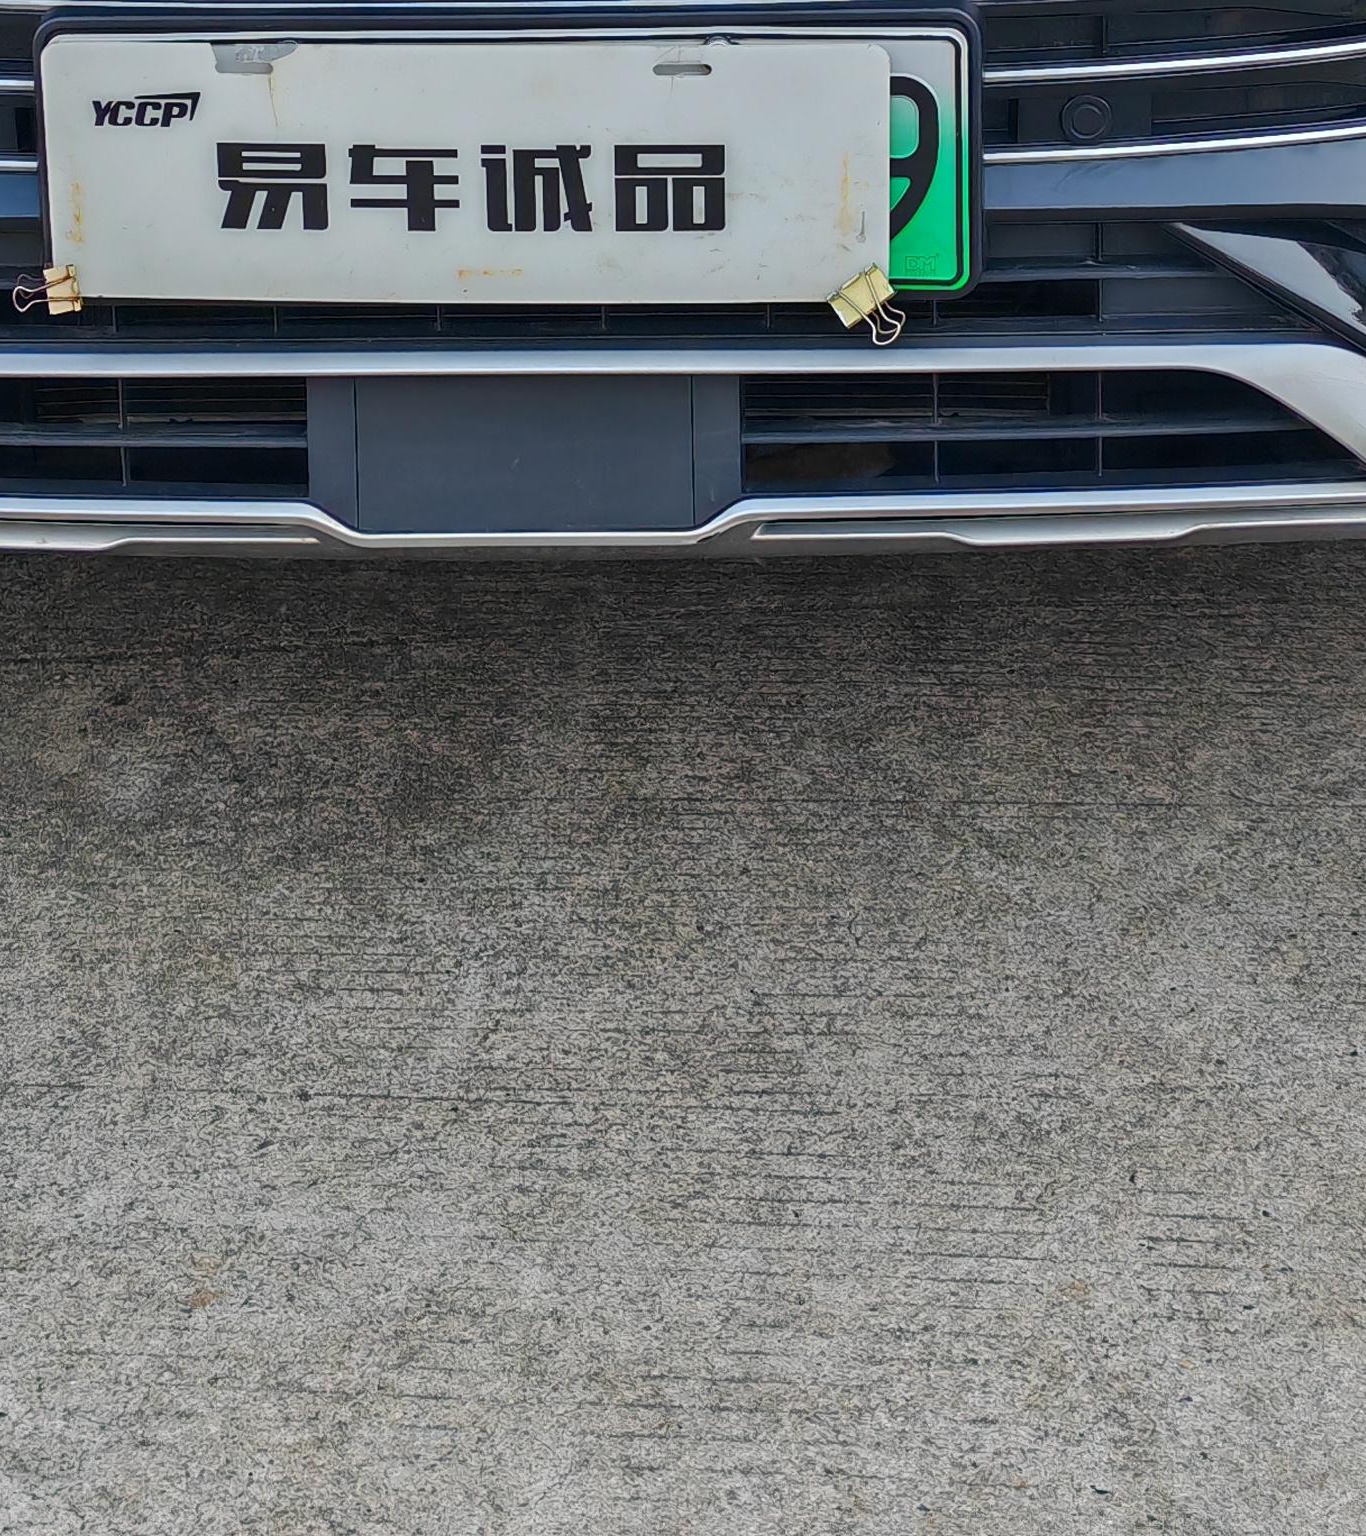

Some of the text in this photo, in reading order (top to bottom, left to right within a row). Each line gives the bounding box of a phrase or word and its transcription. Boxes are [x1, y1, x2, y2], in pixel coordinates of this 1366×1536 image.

[92, 100, 189, 127] YCCP
[216, 143, 726, 232] 易车诚品
